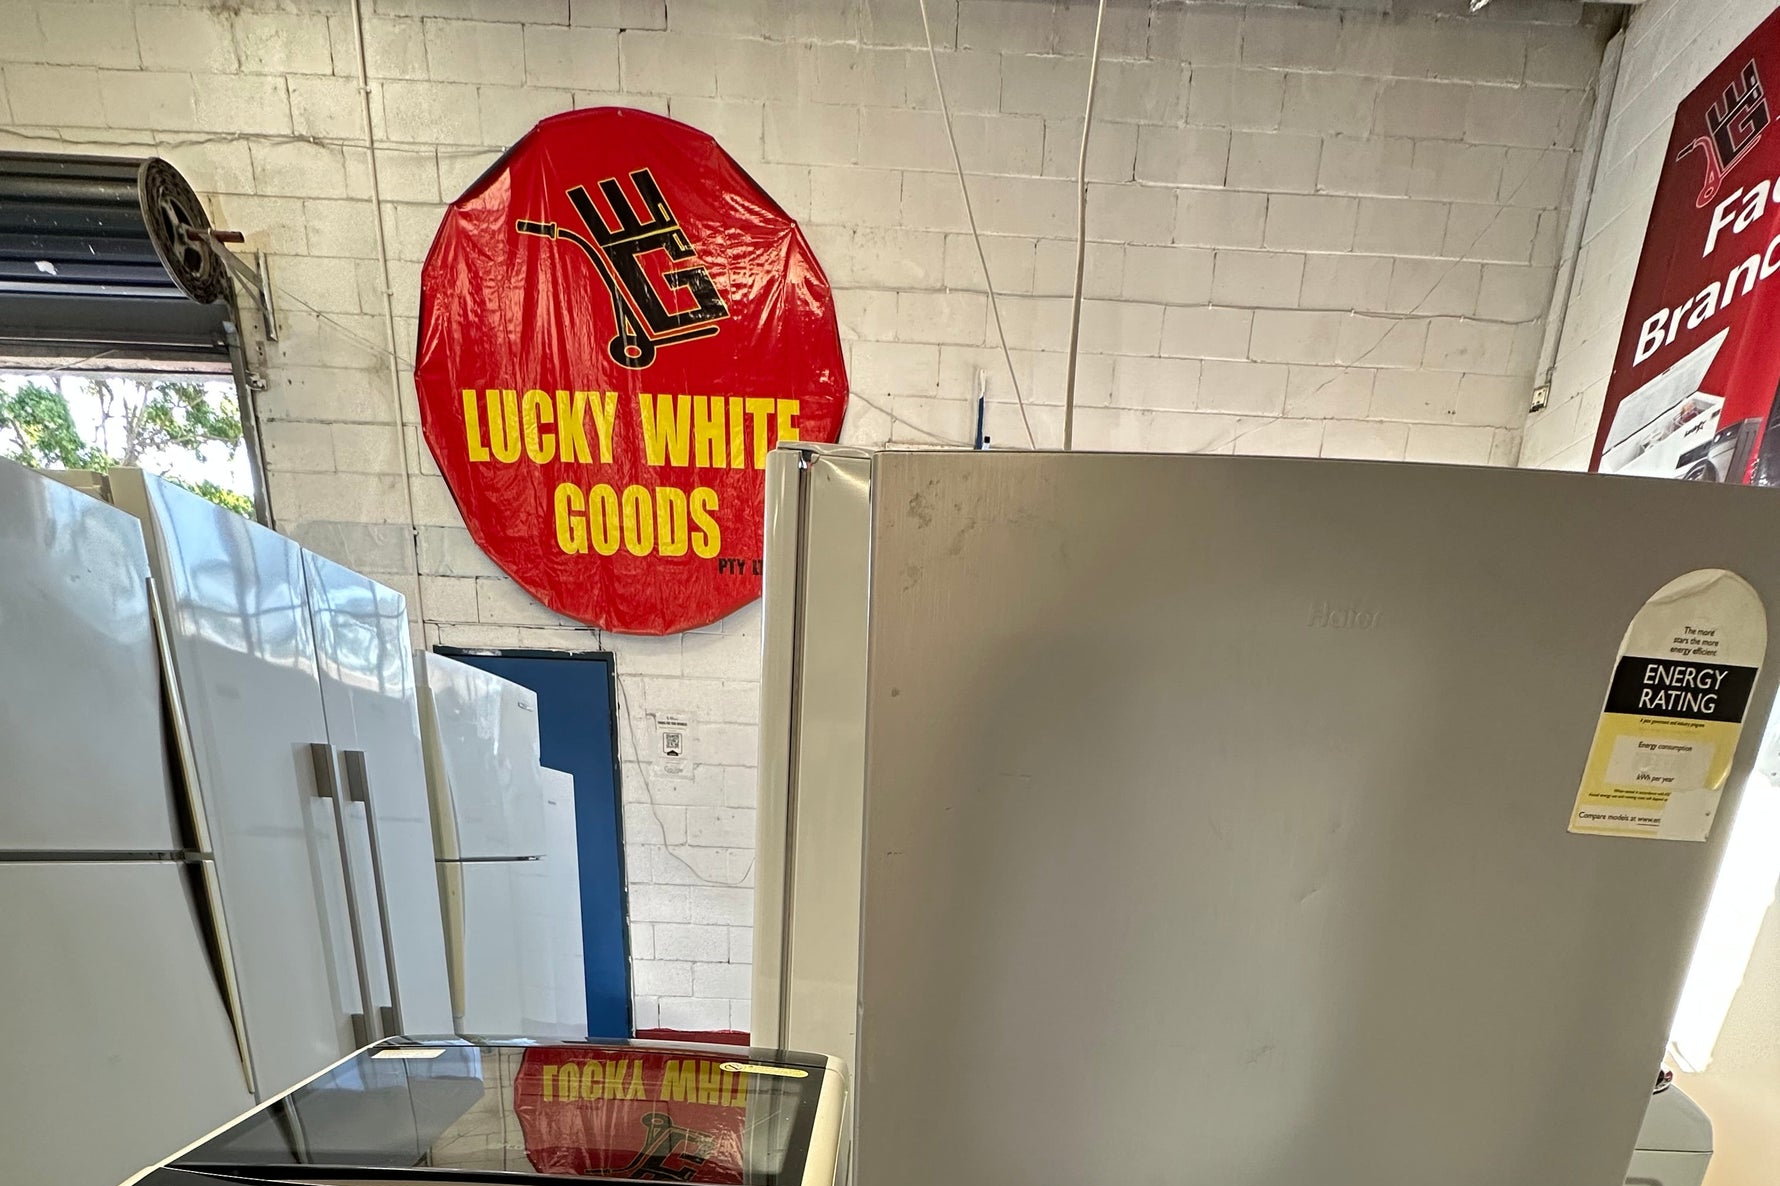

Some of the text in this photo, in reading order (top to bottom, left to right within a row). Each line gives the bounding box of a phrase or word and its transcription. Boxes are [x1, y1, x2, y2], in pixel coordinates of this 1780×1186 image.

[462, 389, 800, 470] LUCKY WHITE
[554, 482, 721, 559] GOODS
[718, 557, 764, 576] PTY LT
[1684, 626, 1696, 635] The
[1670, 647, 1692, 656] energy
[1643, 664, 1728, 690] ENERGY
[1638, 688, 1718, 714] RATING
[1638, 741, 1693, 752] Energy consumption
[1578, 812, 1606, 820] Compare
[1608, 814, 1628, 822] models
